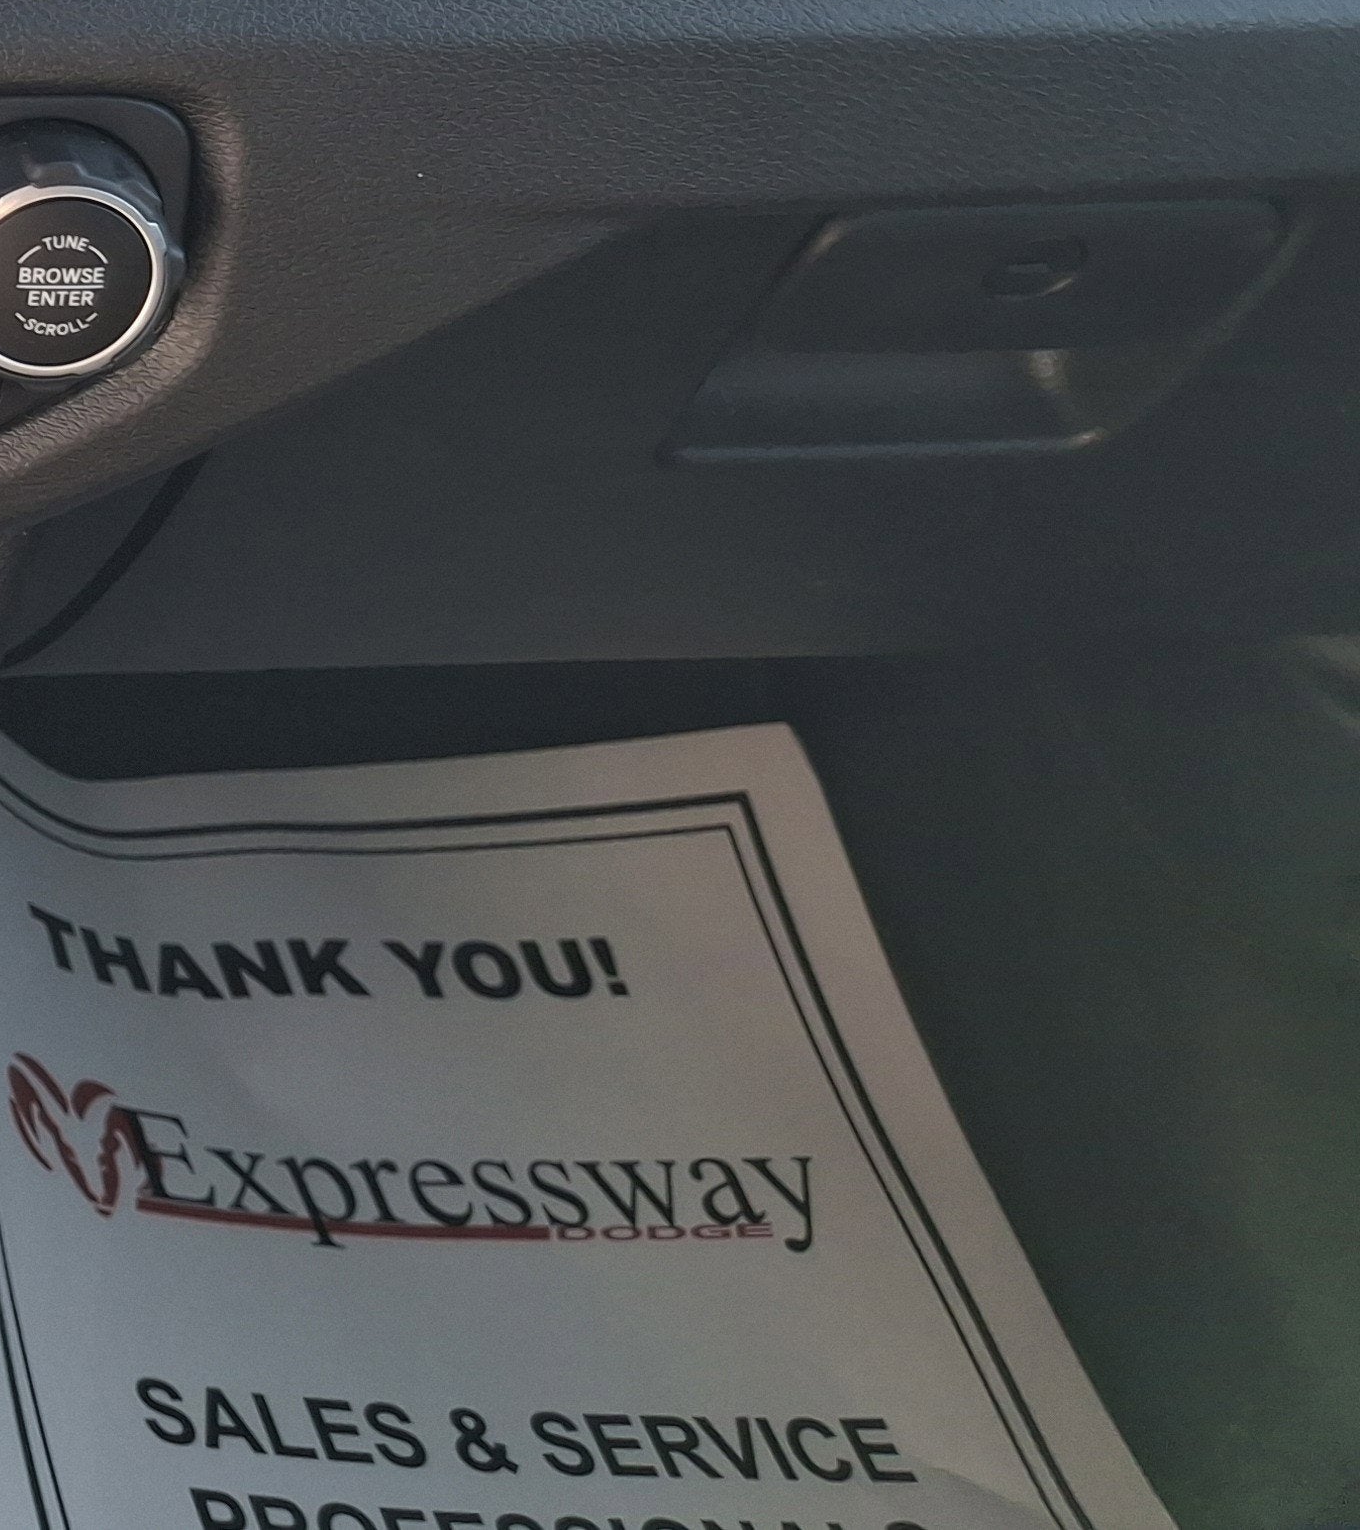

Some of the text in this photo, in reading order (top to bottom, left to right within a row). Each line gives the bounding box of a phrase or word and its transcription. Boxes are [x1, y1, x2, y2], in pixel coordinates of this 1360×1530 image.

[41, 234, 89, 253] TUNE
[17, 266, 105, 286] BROWSE
[26, 289, 95, 308] ENTER
[22, 316, 92, 337] SCROLL
[27, 900, 632, 1000] THANK YOU!
[111, 1105, 814, 1254] Expressway
[547, 1221, 775, 1241] DODGE
[135, 1376, 921, 1484] SALES & SERVICE
